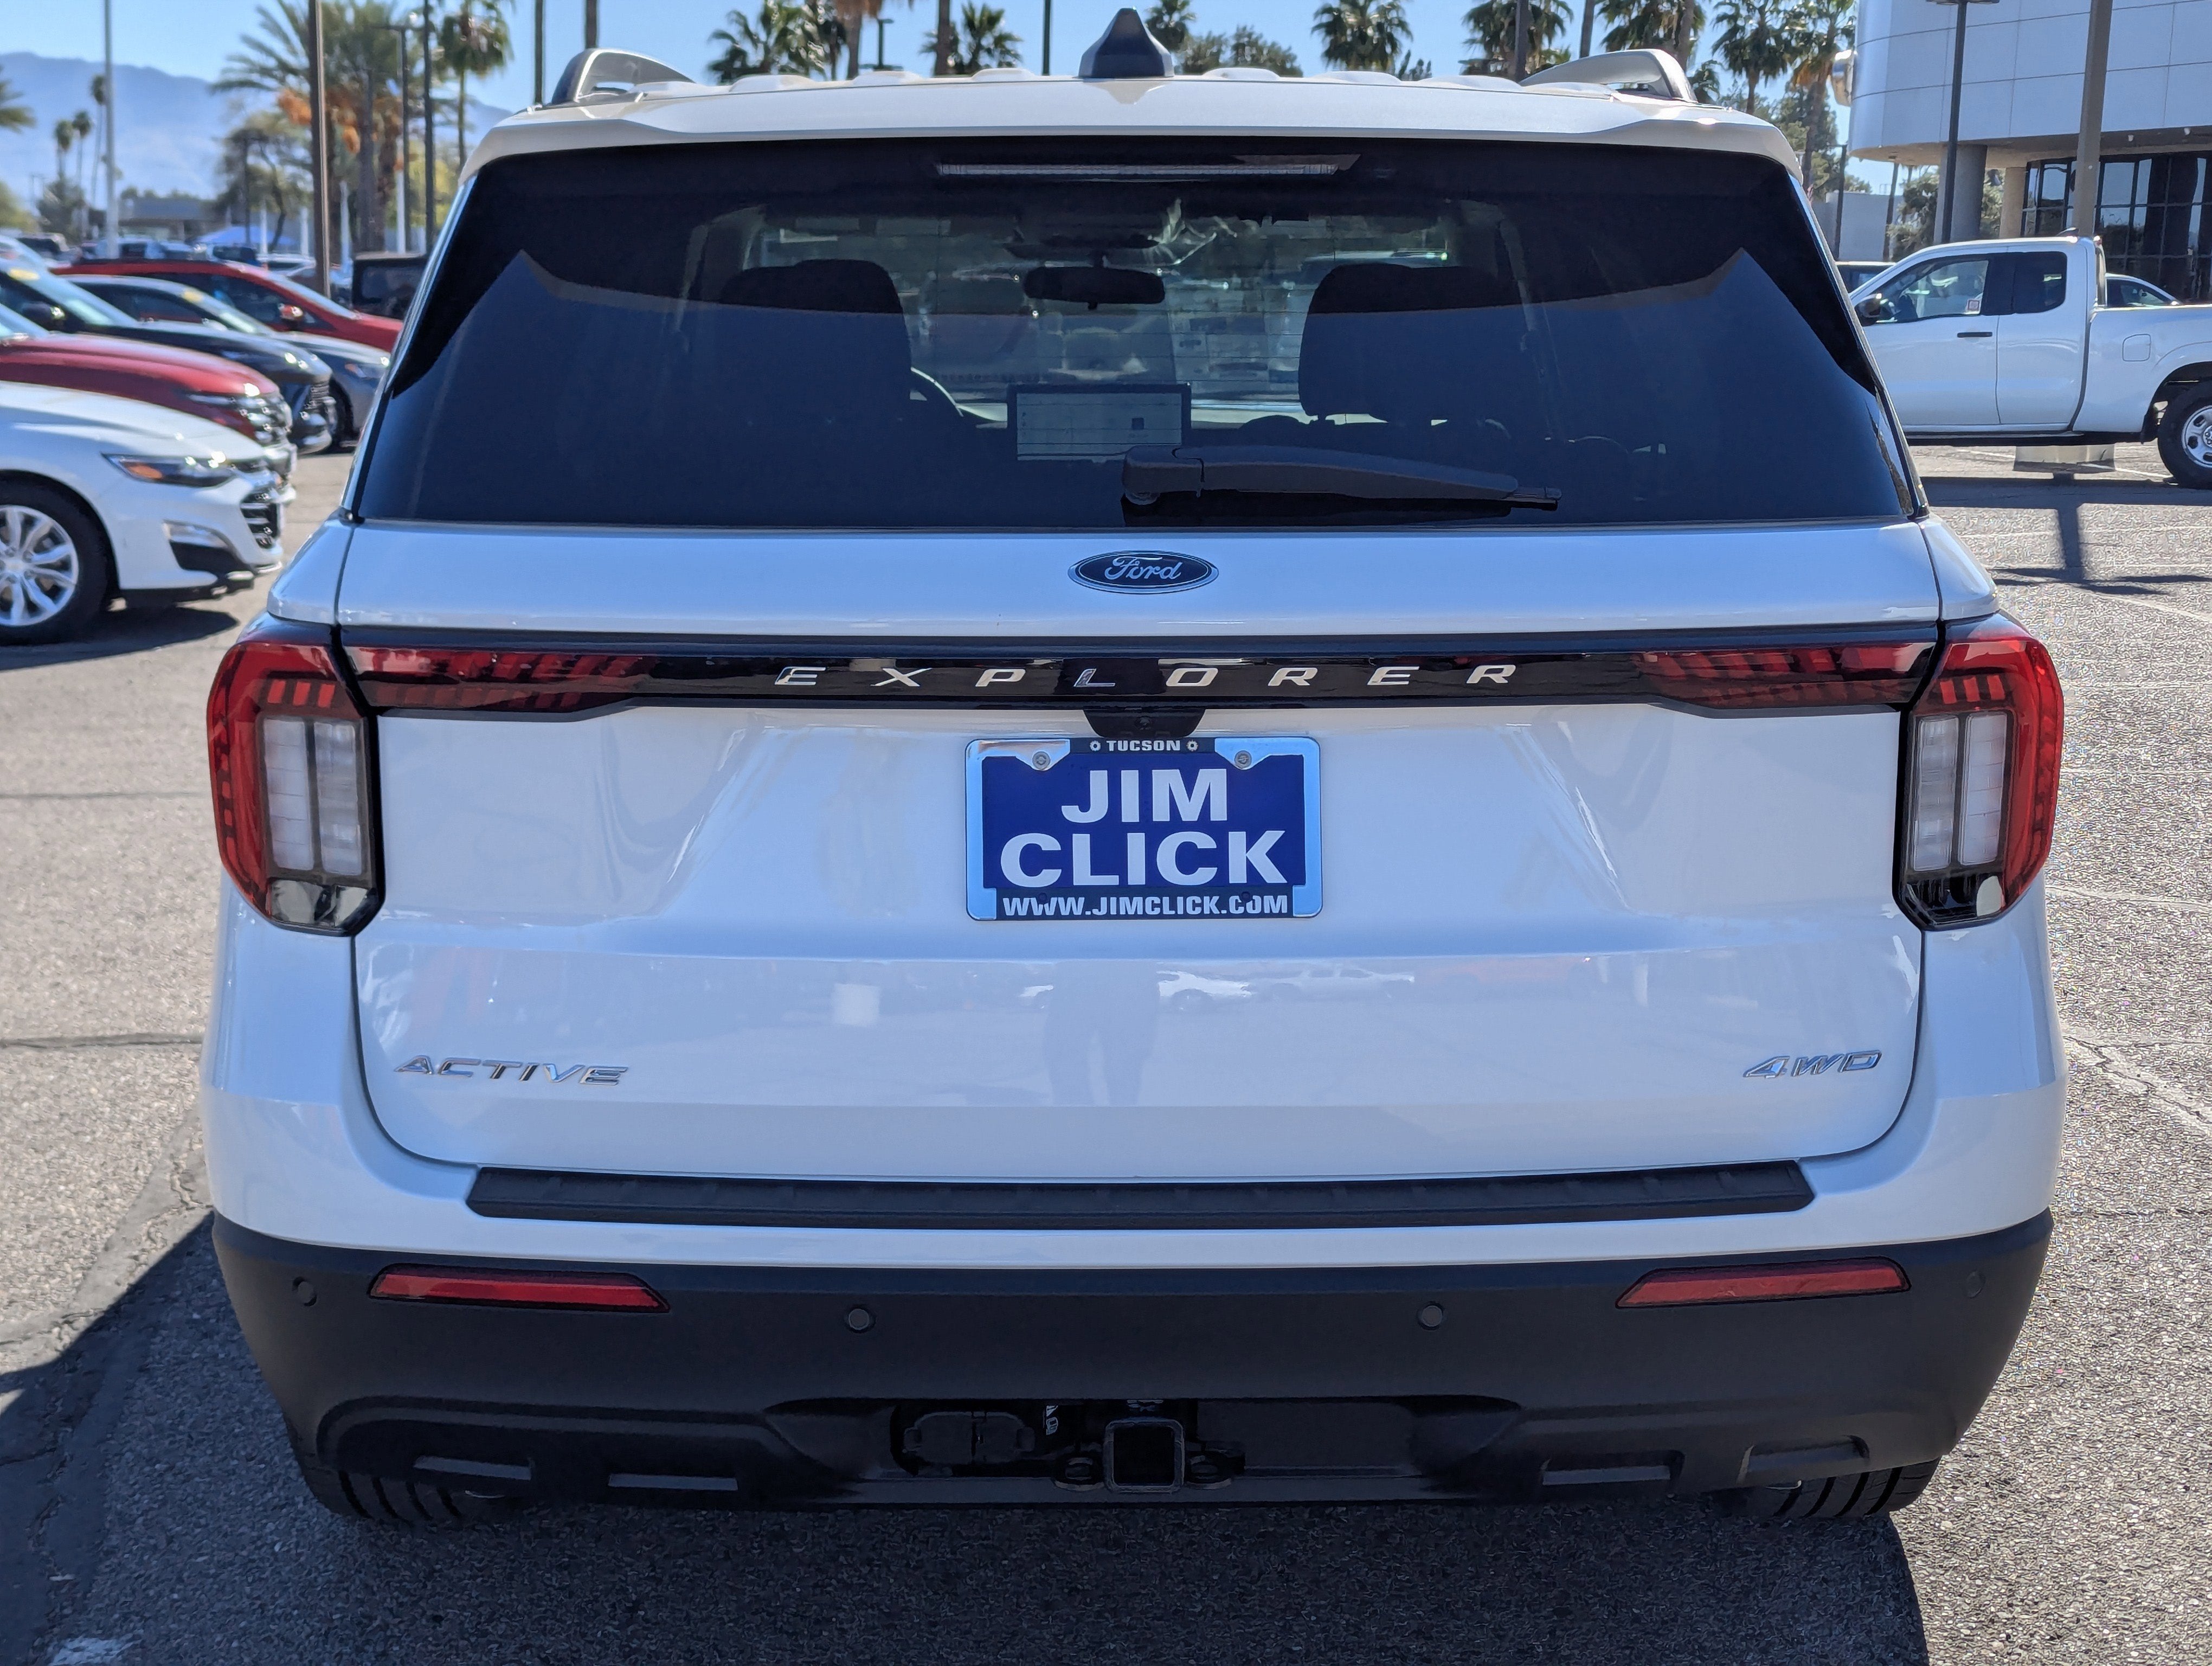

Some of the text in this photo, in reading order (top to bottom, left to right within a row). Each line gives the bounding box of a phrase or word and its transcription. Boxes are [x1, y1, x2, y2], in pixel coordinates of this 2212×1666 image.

[1104, 556, 1183, 580] Ford
[774, 664, 1516, 687] EXPLORER
[1106, 740, 1180, 752] TUCSON
[1061, 768, 1227, 823] JIM
[1000, 830, 1288, 887] CLICK
[1002, 895, 1288, 916] WWW.JIMCLICK.COM
[394, 1054, 629, 1086] ACTIVE
[1742, 1049, 1882, 1079] 4WD
